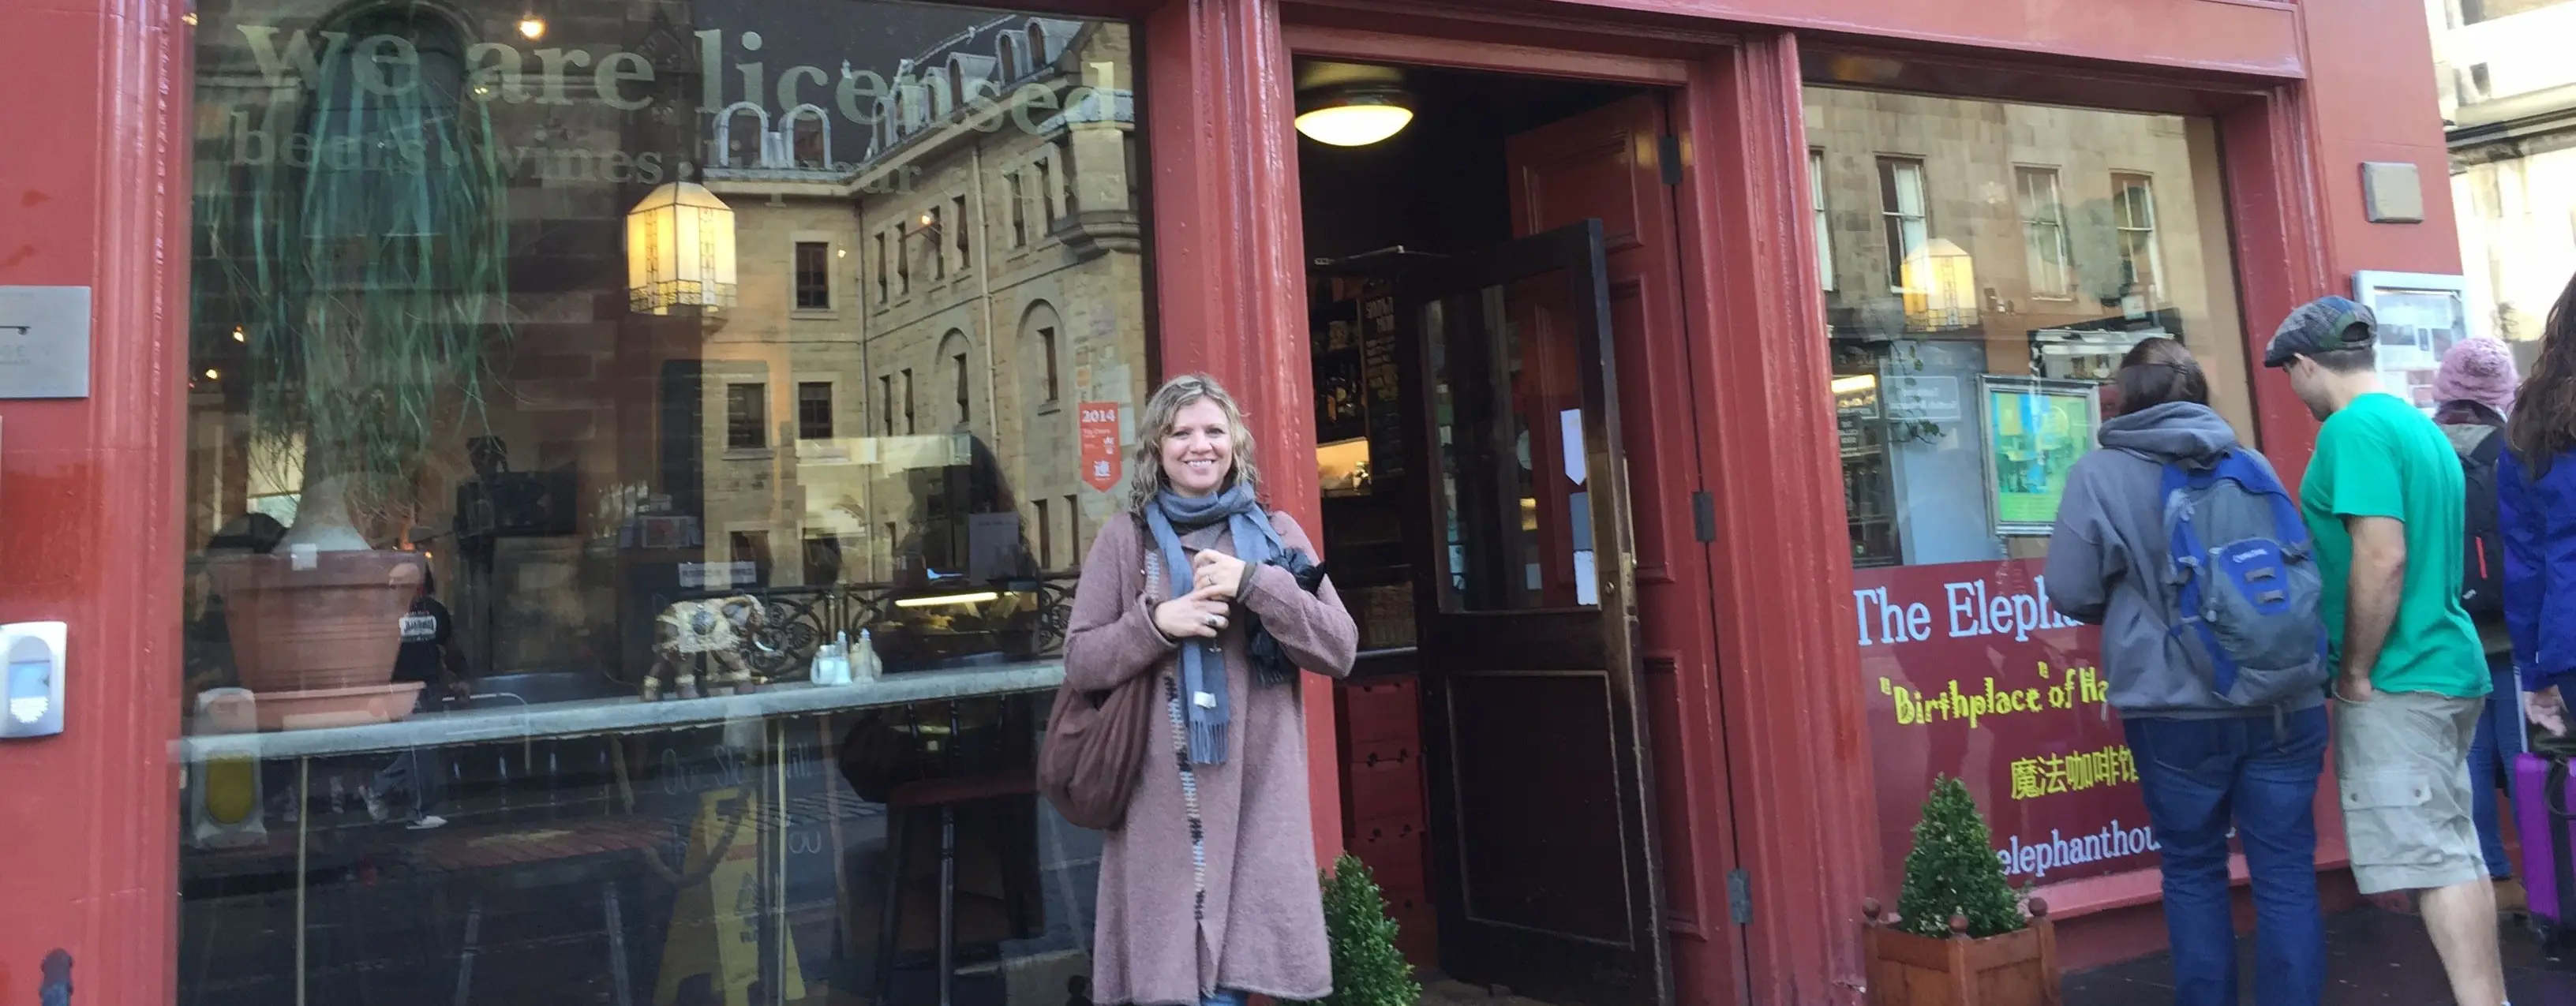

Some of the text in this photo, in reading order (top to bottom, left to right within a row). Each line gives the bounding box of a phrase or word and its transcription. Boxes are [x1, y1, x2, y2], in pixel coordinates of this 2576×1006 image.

[237, 23, 1115, 135] we are licensed
[1082, 410, 1116, 422] 2014
[1853, 574, 2084, 645] The Eleph
[2049, 668, 2076, 709] of
